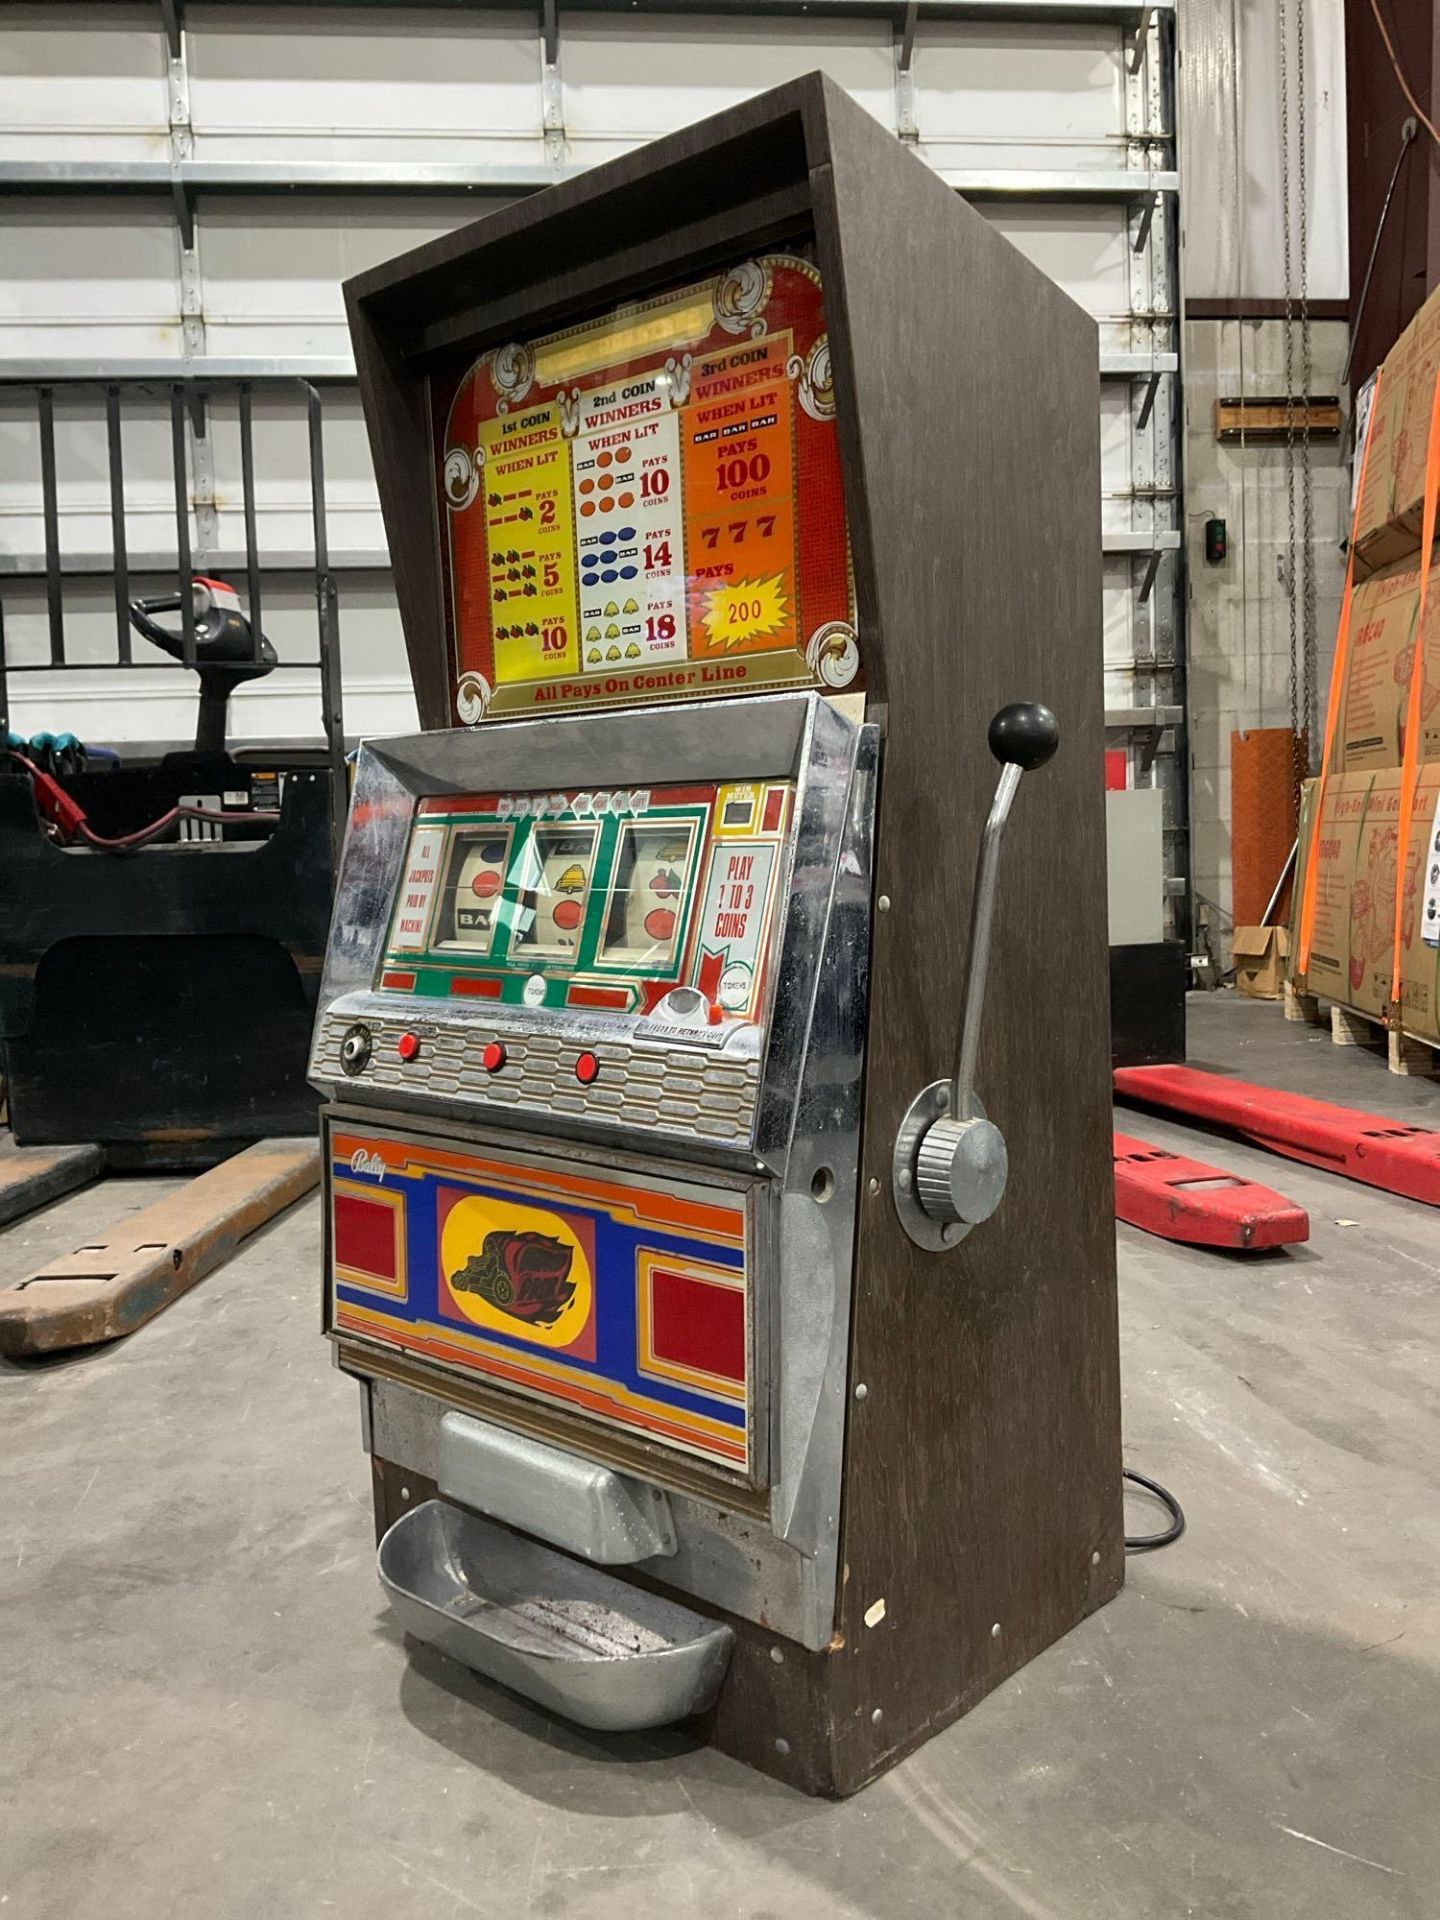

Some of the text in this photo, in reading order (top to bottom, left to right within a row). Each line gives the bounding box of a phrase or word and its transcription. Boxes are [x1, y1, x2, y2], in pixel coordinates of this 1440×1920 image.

[701, 347, 768, 377] 3rd COIN
[695, 363, 784, 400] WINNERS
[593, 380, 655, 408] 2nd COIN
[585, 397, 662, 429] WINNERS
[697, 391, 777, 424] WHEN LIT
[502, 411, 550, 435] 1st COIN
[694, 416, 775, 443] BAR BAR BAR
[490, 427, 558, 456] WINNERS
[588, 423, 659, 451] WHEN LIT
[717, 437, 758, 459] PAYS
[496, 450, 558, 476] WHEN LIT
[642, 455, 668, 467] PAYS
[715, 453, 771, 492] 100
[536, 489, 558, 501] PAYS
[640, 468, 670, 498] 10
[730, 486, 767, 501] COINS
[539, 500, 556, 525] 2
[642, 496, 669, 508] COINS
[538, 524, 561, 535] COINS
[645, 528, 671, 540] PAYS
[701, 515, 777, 549] 7 7 7
[539, 552, 561, 562] PAYS
[643, 540, 672, 570] 14
[543, 562, 559, 587] 5
[645, 569, 671, 580] COINS
[695, 563, 734, 578] PAYS
[541, 587, 564, 597] COINS
[647, 600, 673, 611] PAYS
[728, 599, 762, 624] 200
[542, 615, 565, 626] PAYS
[645, 613, 676, 641] 18
[541, 625, 568, 652] 10
[649, 641, 676, 651] COINS
[544, 652, 567, 661] COINS
[534, 664, 747, 702] All Pays On Center Line
[421, 845, 431, 859] ALL
[408, 869, 435, 883] JACKPOTS
[727, 856, 754, 880] PLAY
[406, 894, 419, 908] PAID
[718, 884, 754, 909] 1 TO 3
[400, 919, 423, 933] MACHINE
[459, 913, 490, 926] BA
[714, 912, 748, 938] COINS
[351, 1148, 387, 1183] Bally
